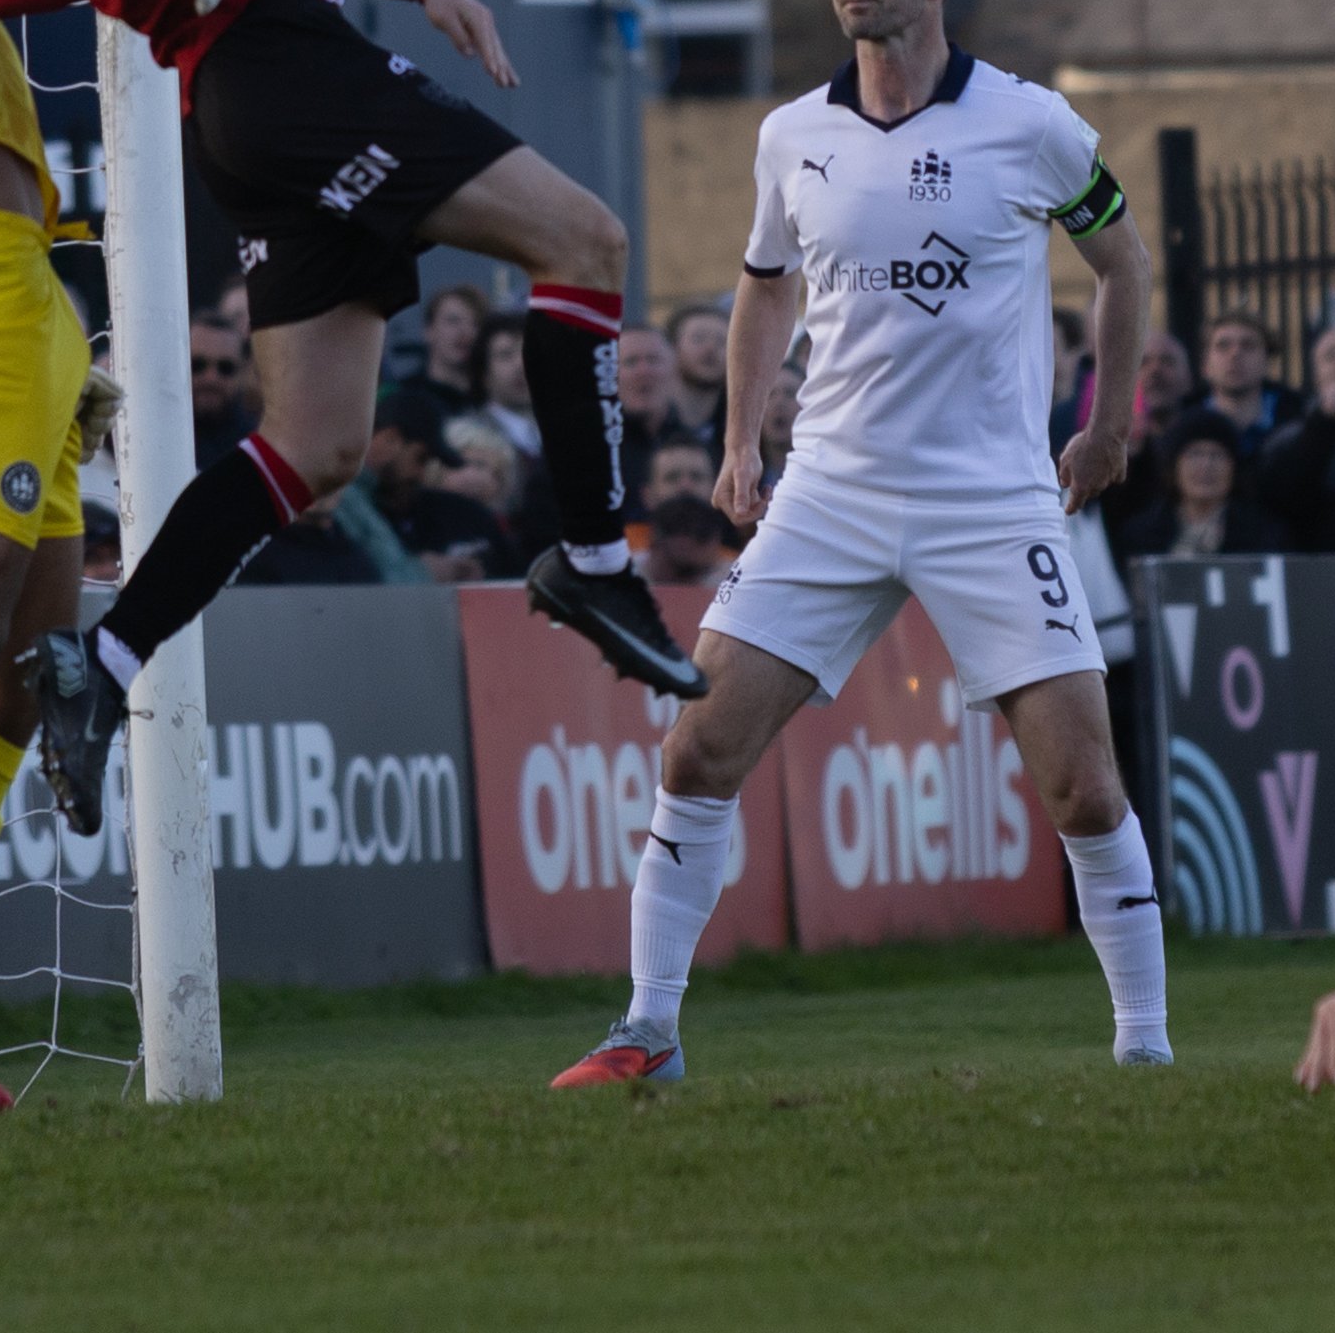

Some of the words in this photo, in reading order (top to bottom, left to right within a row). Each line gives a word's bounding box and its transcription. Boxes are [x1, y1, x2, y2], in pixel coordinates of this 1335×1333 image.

[908, 185, 952, 202] 1930
[815, 259, 972, 295] WhiteBOX
[1027, 543, 1070, 608] 9
